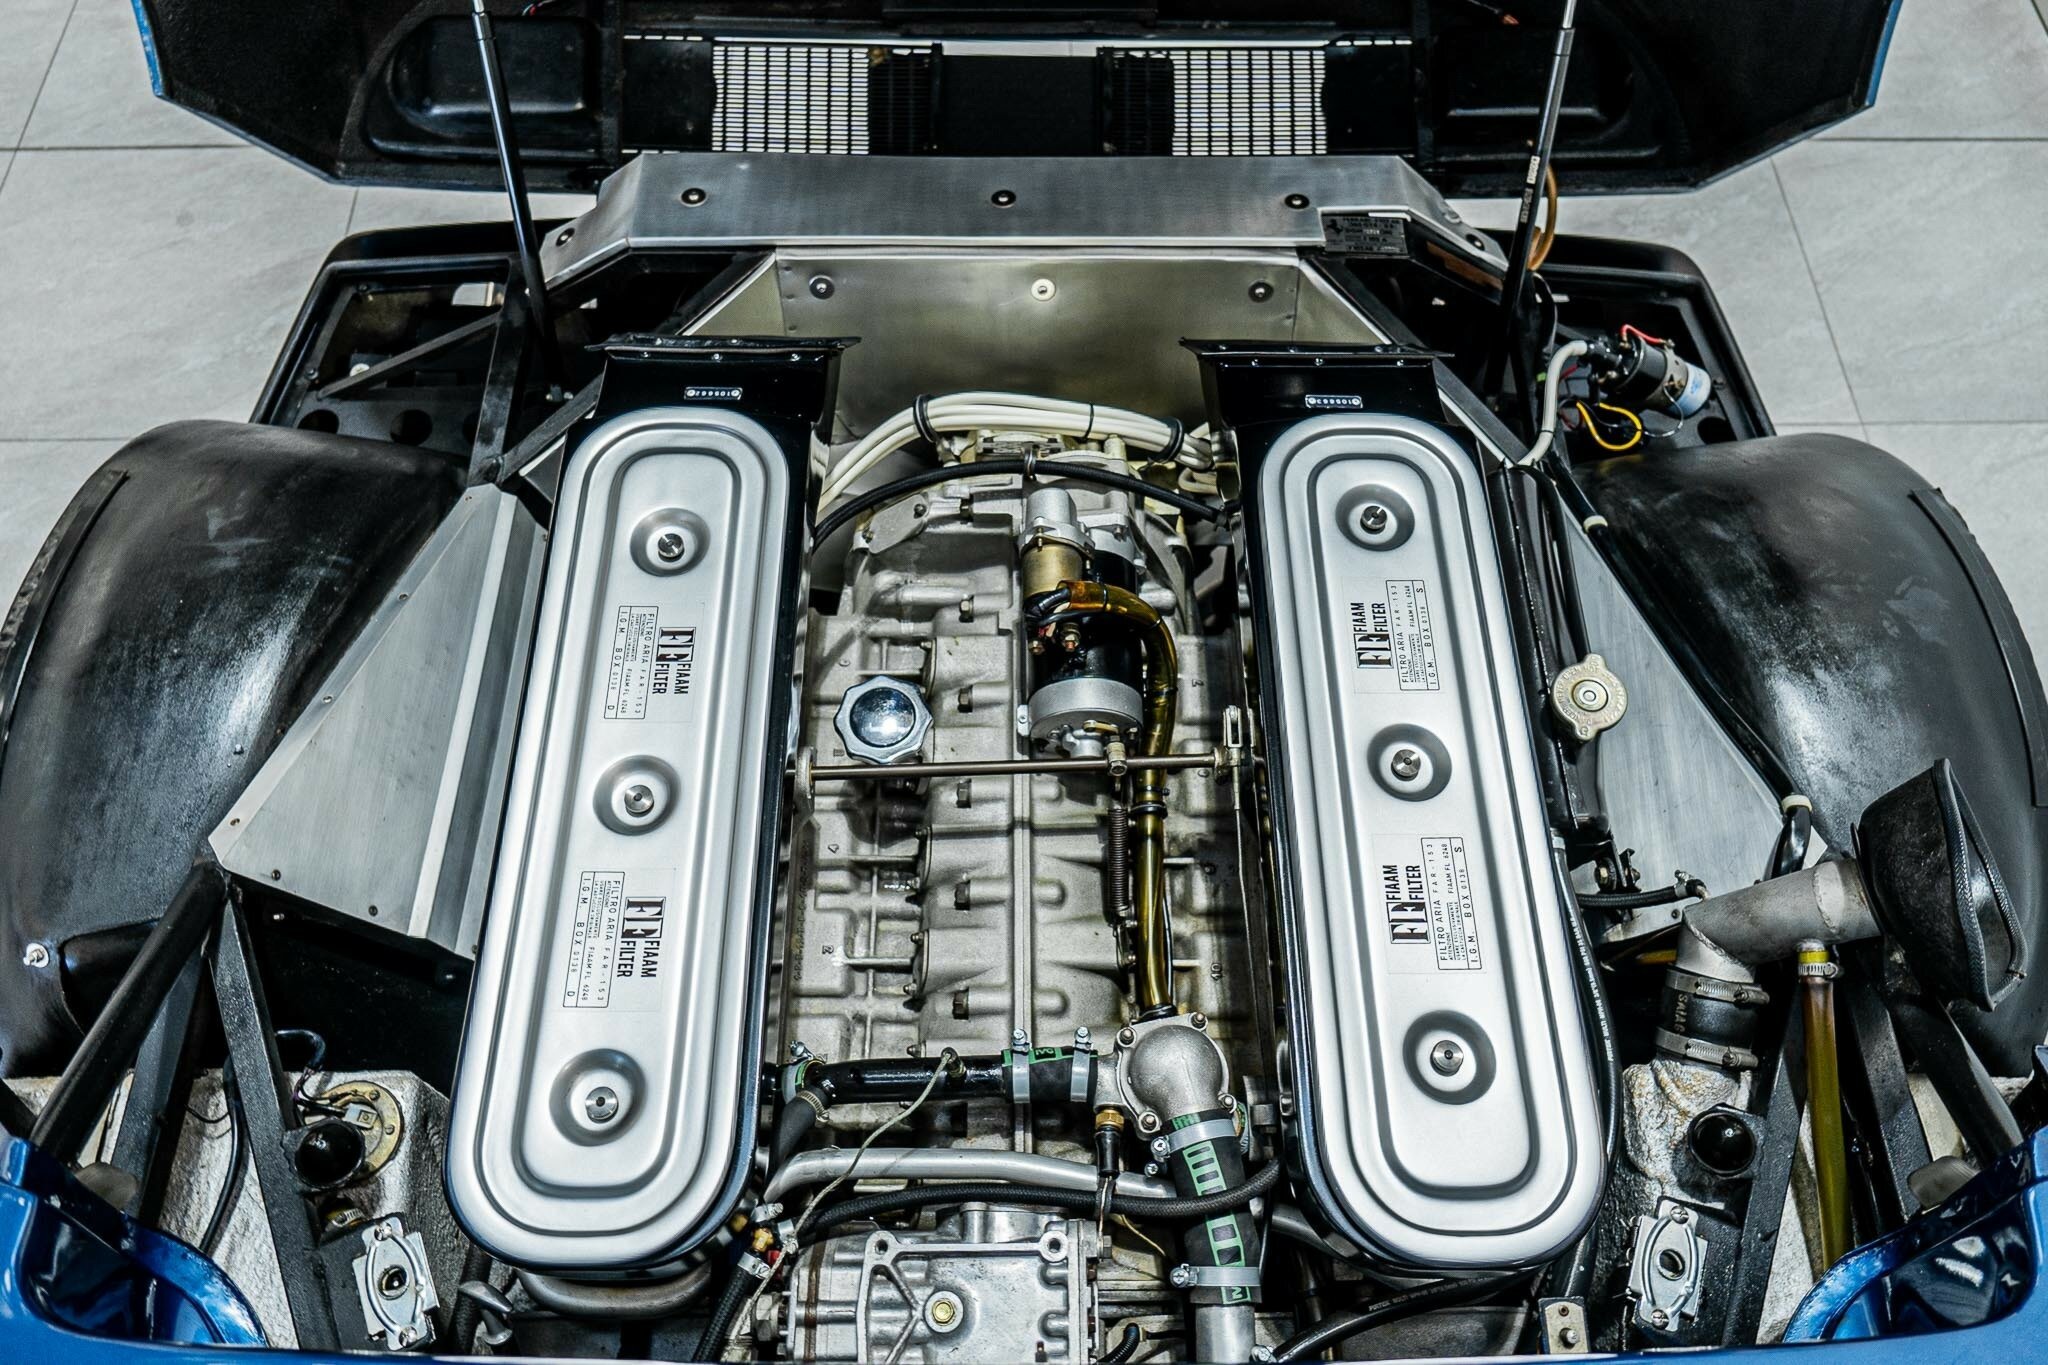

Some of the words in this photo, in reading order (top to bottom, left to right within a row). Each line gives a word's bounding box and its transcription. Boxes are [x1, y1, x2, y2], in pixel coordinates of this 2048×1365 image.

[645, 614, 654, 641] FILTRO
[1350, 602, 1367, 632] FIAAM
[1371, 603, 1389, 632] FILTER
[1397, 632, 1405, 651] ARIA
[1422, 627, 1431, 647] BOX
[614, 648, 622, 667] BOX
[1399, 654, 1409, 683] FILTRO
[624, 669, 632, 686] FIAAM
[652, 663, 670, 694] FILTER
[674, 663, 691, 694] FIAAM
[1382, 865, 1401, 900] FIAAM
[1405, 865, 1424, 900] FILTER
[1446, 873, 1454, 893] FIAAM
[610, 880, 620, 914] FILTRO
[1434, 899, 1443, 922] ARIA
[1462, 894, 1472, 918] BOX
[574, 922, 584, 945] BOX
[605, 918, 614, 940] ARIA
[586, 946, 595, 968] FIAAM
[1437, 926, 1448, 961] FILTRO
[617, 940, 636, 978] FILTER
[641, 940, 660, 978] FIAAM
[584, 971, 591, 979] FL
